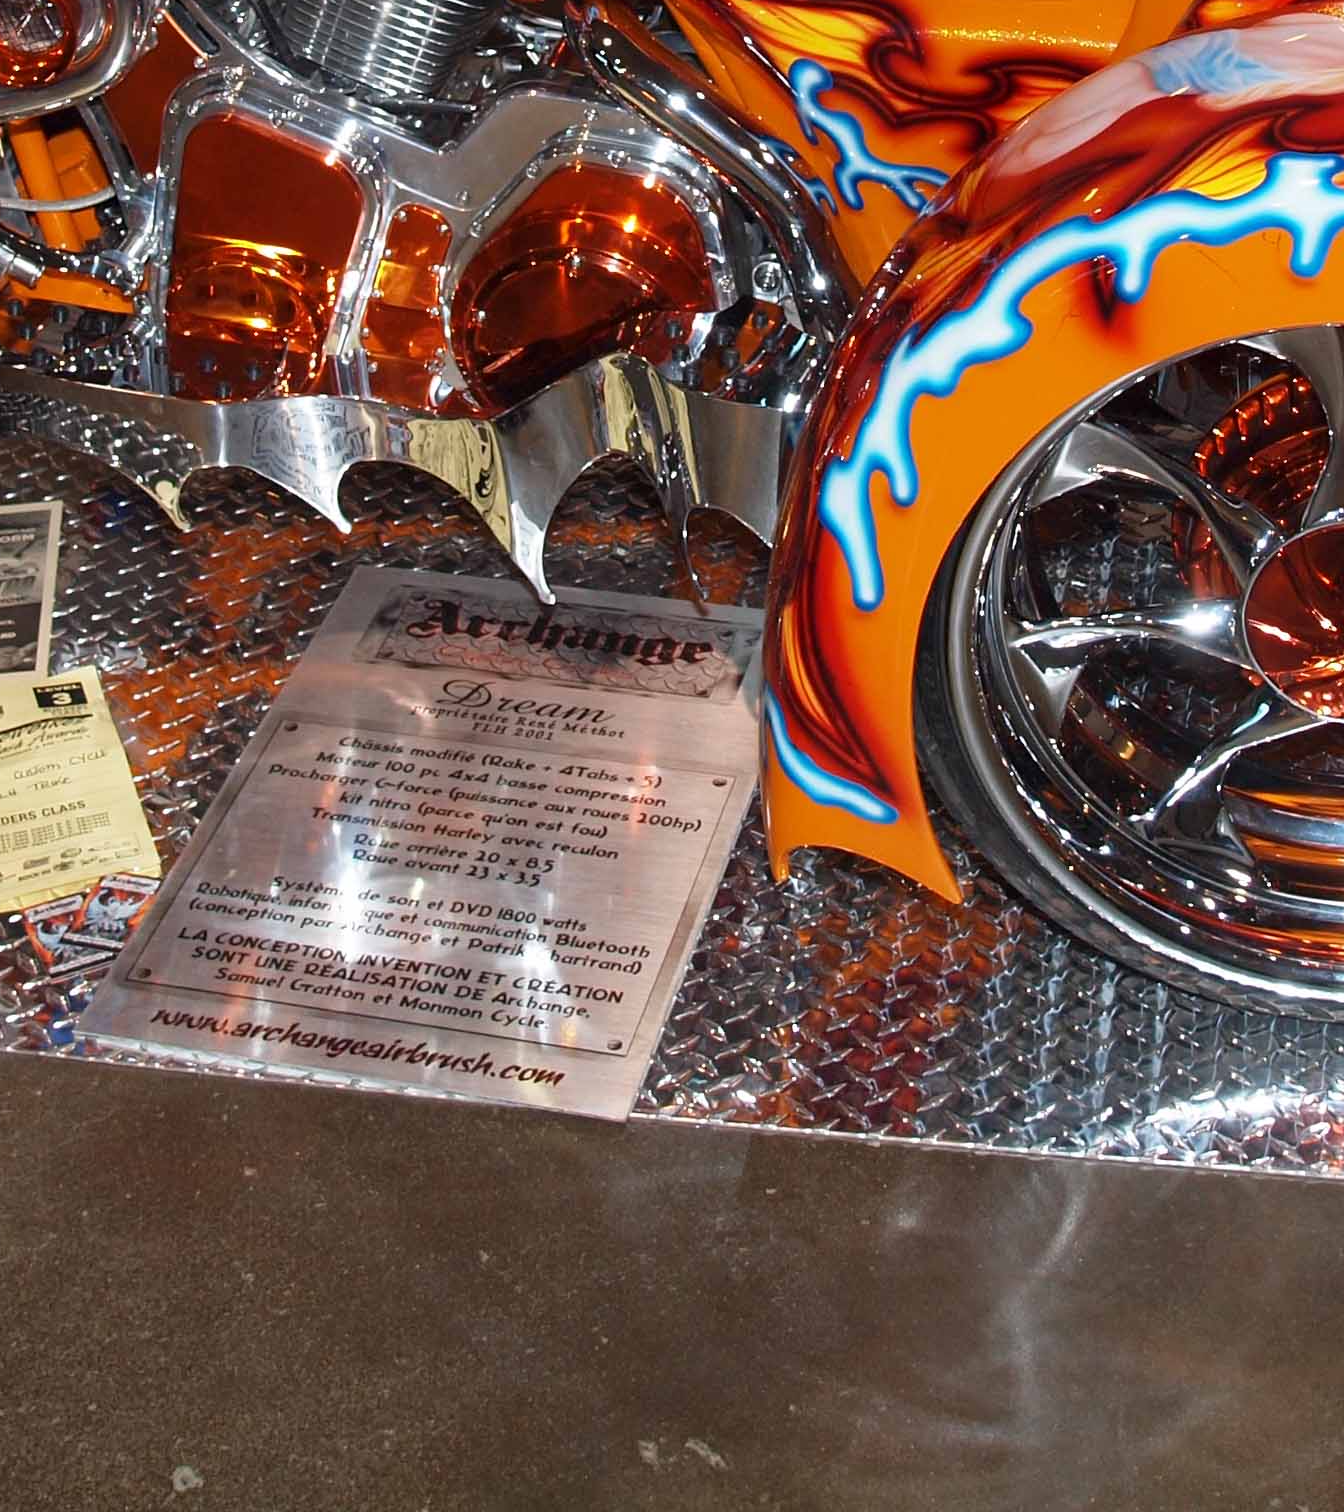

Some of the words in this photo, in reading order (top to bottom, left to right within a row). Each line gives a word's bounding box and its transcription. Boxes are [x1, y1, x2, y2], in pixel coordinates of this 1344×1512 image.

[406, 599, 715, 667] Archange
[50, 692, 72, 706] 3
[412, 702, 509, 726] propriétaire
[516, 716, 556, 730] René
[562, 722, 625, 740] Méthot
[435, 678, 617, 725] Dream
[339, 737, 404, 755] Châssis
[410, 746, 477, 764] modifié
[481, 753, 536, 773] (Rake
[514, 728, 554, 742] 2001
[268, 763, 368, 787] Procharger
[449, 787, 538, 810] (puissance
[544, 803, 576, 816] aux
[582, 808, 630, 823] roues
[636, 812, 703, 833] 200hp)
[316, 751, 379, 770] Moteur
[384, 760, 416, 775] 100
[448, 768, 490, 784] 4x4
[496, 775, 548, 791] basse
[554, 785, 667, 808] compression
[42, 799, 87, 818] CLASS
[312, 806, 426, 834] Transmission
[433, 826, 495, 845] Harley
[501, 837, 544, 850] avec
[552, 843, 620, 861] reculon
[338, 791, 362, 806] kit
[368, 797, 411, 812] nitro
[417, 801, 475, 820] (parce
[481, 813, 529, 828] qu'on
[535, 820, 564, 833] est
[571, 822, 609, 840] fou)
[352, 849, 399, 866] Roue
[404, 859, 460, 875] avant
[465, 866, 490, 881] 23
[495, 872, 508, 882] x
[514, 871, 541, 888] 3.5
[353, 833, 400, 850] Roue
[406, 841, 468, 859] arrière
[474, 850, 501, 865] 20
[505, 857, 518, 868] x
[525, 856, 555, 874] 8.5
[273, 875, 349, 898] Systèm
[357, 887, 381, 902] de
[387, 894, 420, 909] son
[427, 899, 444, 912] et
[449, 901, 493, 918] DVD
[497, 909, 537, 925] 1800
[542, 917, 587, 933] watts
[288, 894, 395, 924] inforque
[400, 912, 419, 927] et
[424, 917, 548, 943] communication
[554, 933, 651, 959] Bluetooth
[189, 896, 296, 924] (conception
[300, 916, 334, 930] par
[440, 934, 460, 948] et
[542, 949, 643, 976] hartrand)
[178, 927, 207, 943] LA
[357, 953, 472, 981] INVENTION
[477, 971, 507, 986] ET
[512, 976, 624, 1004] CRÉATION
[191, 946, 251, 965] SONT
[255, 955, 301, 973] UNE
[304, 961, 449, 995] RÉALISATION
[455, 985, 487, 1001] DE
[215, 967, 285, 989] Samuel
[290, 978, 365, 1002] Gratton
[372, 993, 393, 1006] et
[399, 996, 483, 1020] Monmon
[149, 1007, 567, 1088] www.archangeairbrush.com
